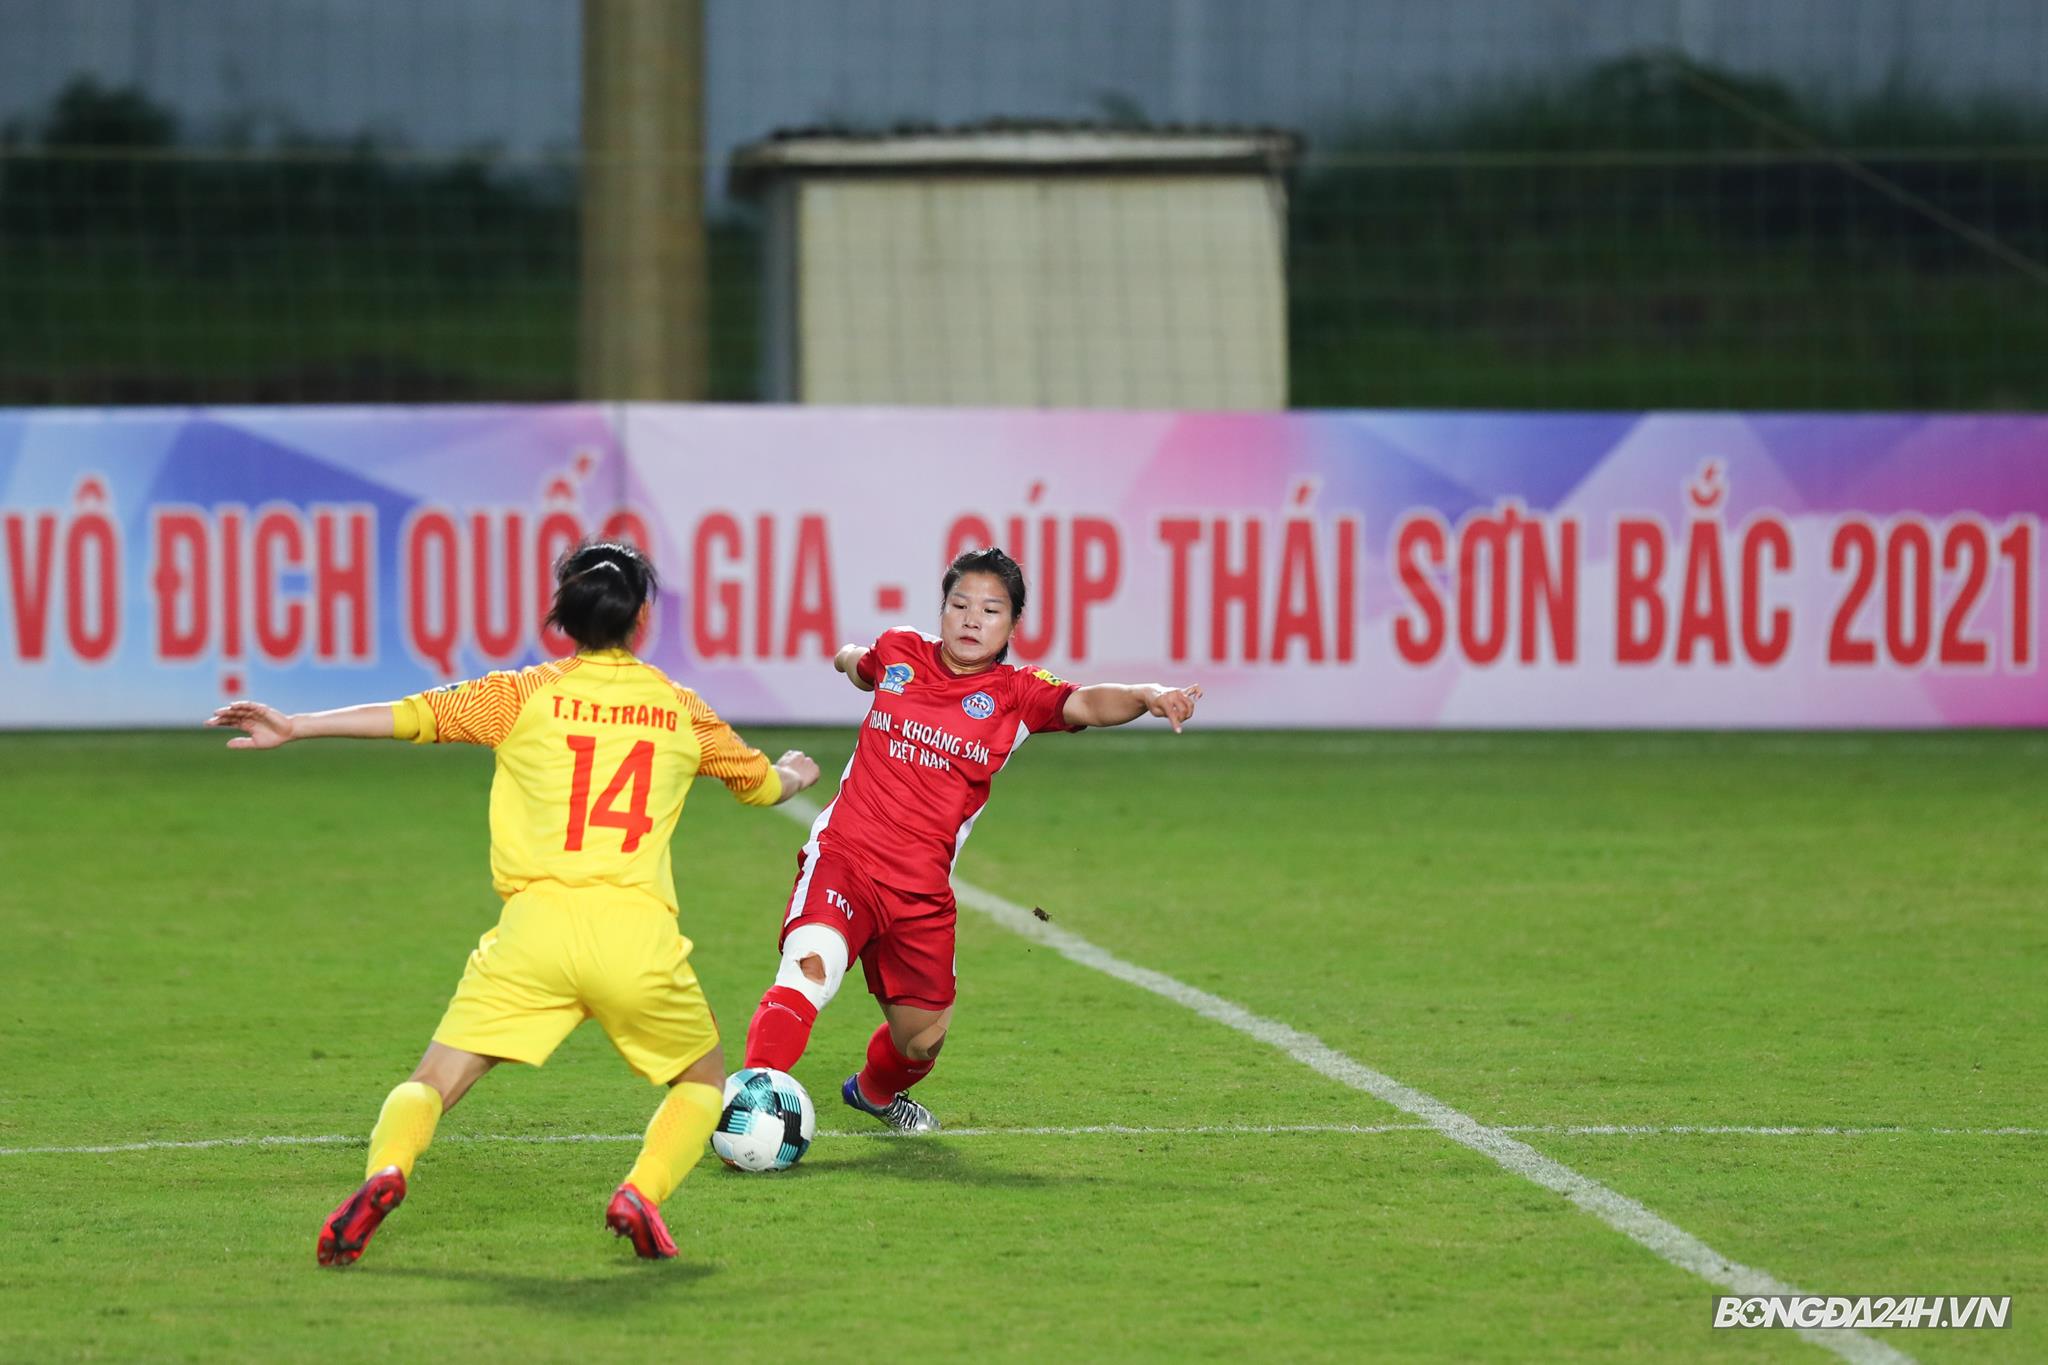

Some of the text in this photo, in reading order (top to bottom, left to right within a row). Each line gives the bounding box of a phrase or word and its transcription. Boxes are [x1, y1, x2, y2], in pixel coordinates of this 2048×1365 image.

[5, 477, 119, 662] VÔ
[153, 509, 370, 695] ĐỊCH
[692, 511, 840, 660] GIA
[877, 584, 907, 611] -
[944, 482, 1119, 661] ÚP
[1159, 485, 1354, 662] THÁI
[1395, 505, 1577, 666] SƠN
[1615, 463, 1791, 667] BẮC
[1828, 522, 2031, 667] 2021
[553, 696, 678, 732] T.T.T.TRANG
[902, 719, 962, 755] KHOÁNG
[889, 739, 951, 772] VIỆT NAM
[564, 734, 655, 853] 14
[826, 888, 854, 921] TKV
